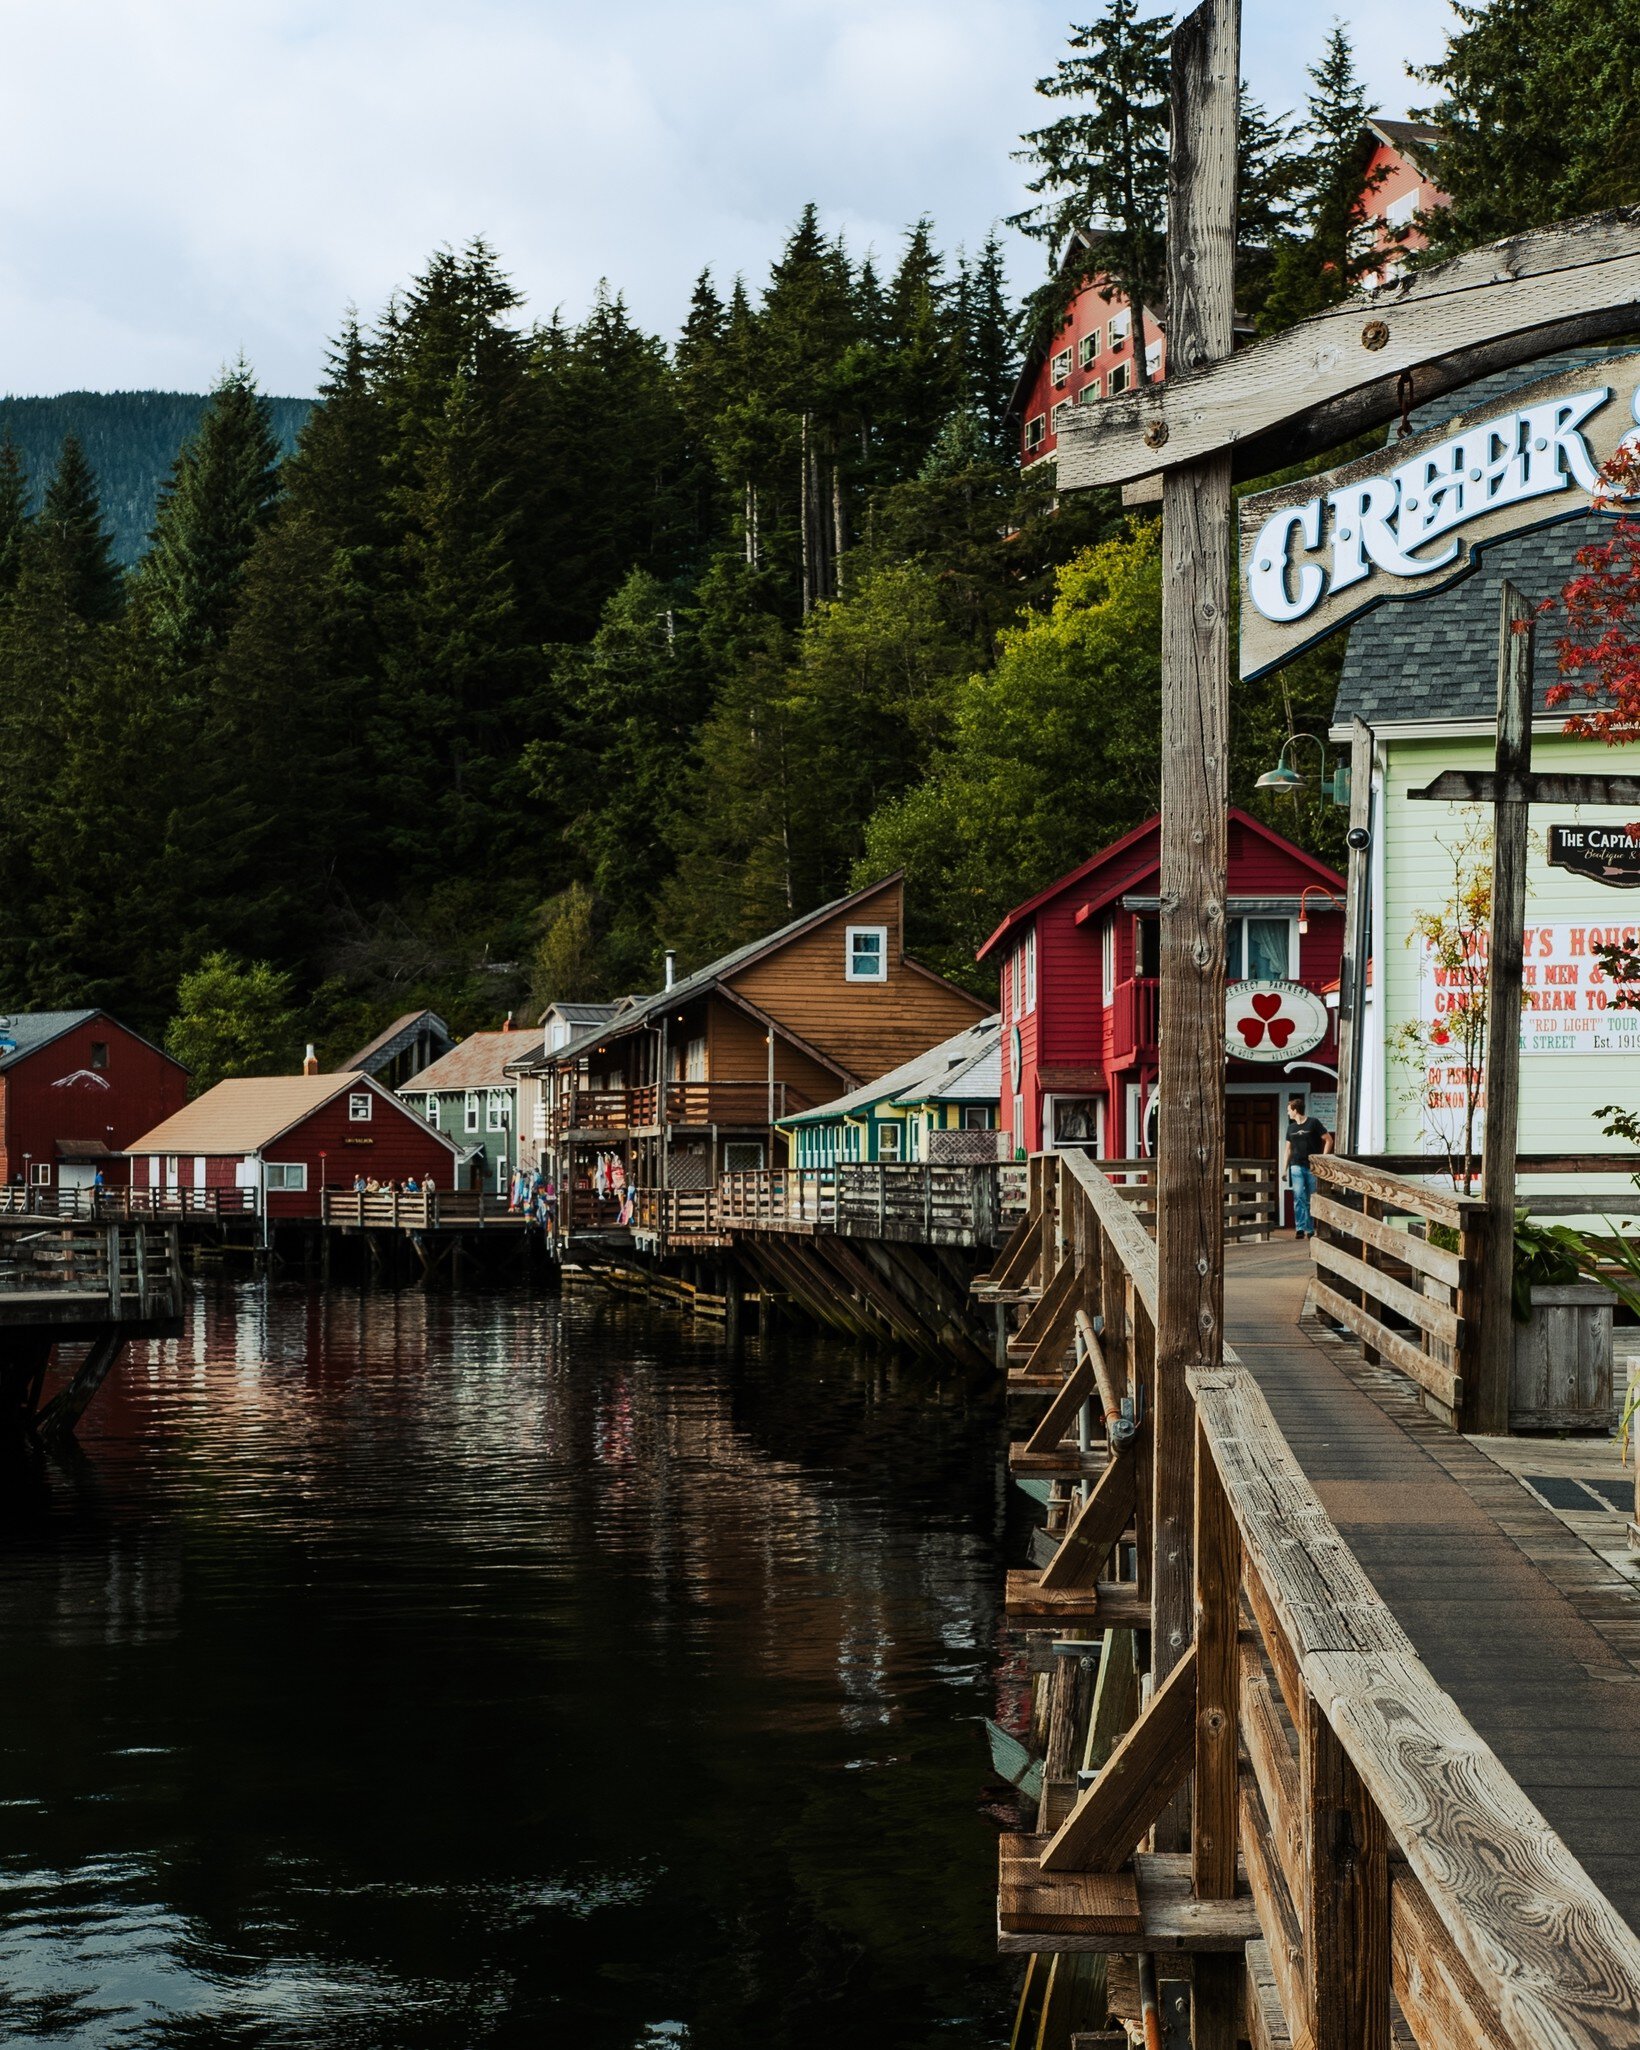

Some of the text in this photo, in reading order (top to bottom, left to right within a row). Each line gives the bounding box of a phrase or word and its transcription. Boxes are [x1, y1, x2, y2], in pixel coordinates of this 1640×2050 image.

[1247, 386, 1638, 622] CREEK
[1558, 829, 1640, 849] THE CAPTAI
[1577, 848, 1625, 866] Boutique
[1569, 926, 1640, 957] HOUS
[1543, 964, 1579, 985] MEN
[1226, 981, 1310, 999] ERFECT PARTNERS
[1585, 989, 1608, 1011] TO
[1607, 1017, 1638, 1032] TOUR
[1532, 1035, 1577, 1050] STREET
[1593, 1034, 1614, 1049] Est.
